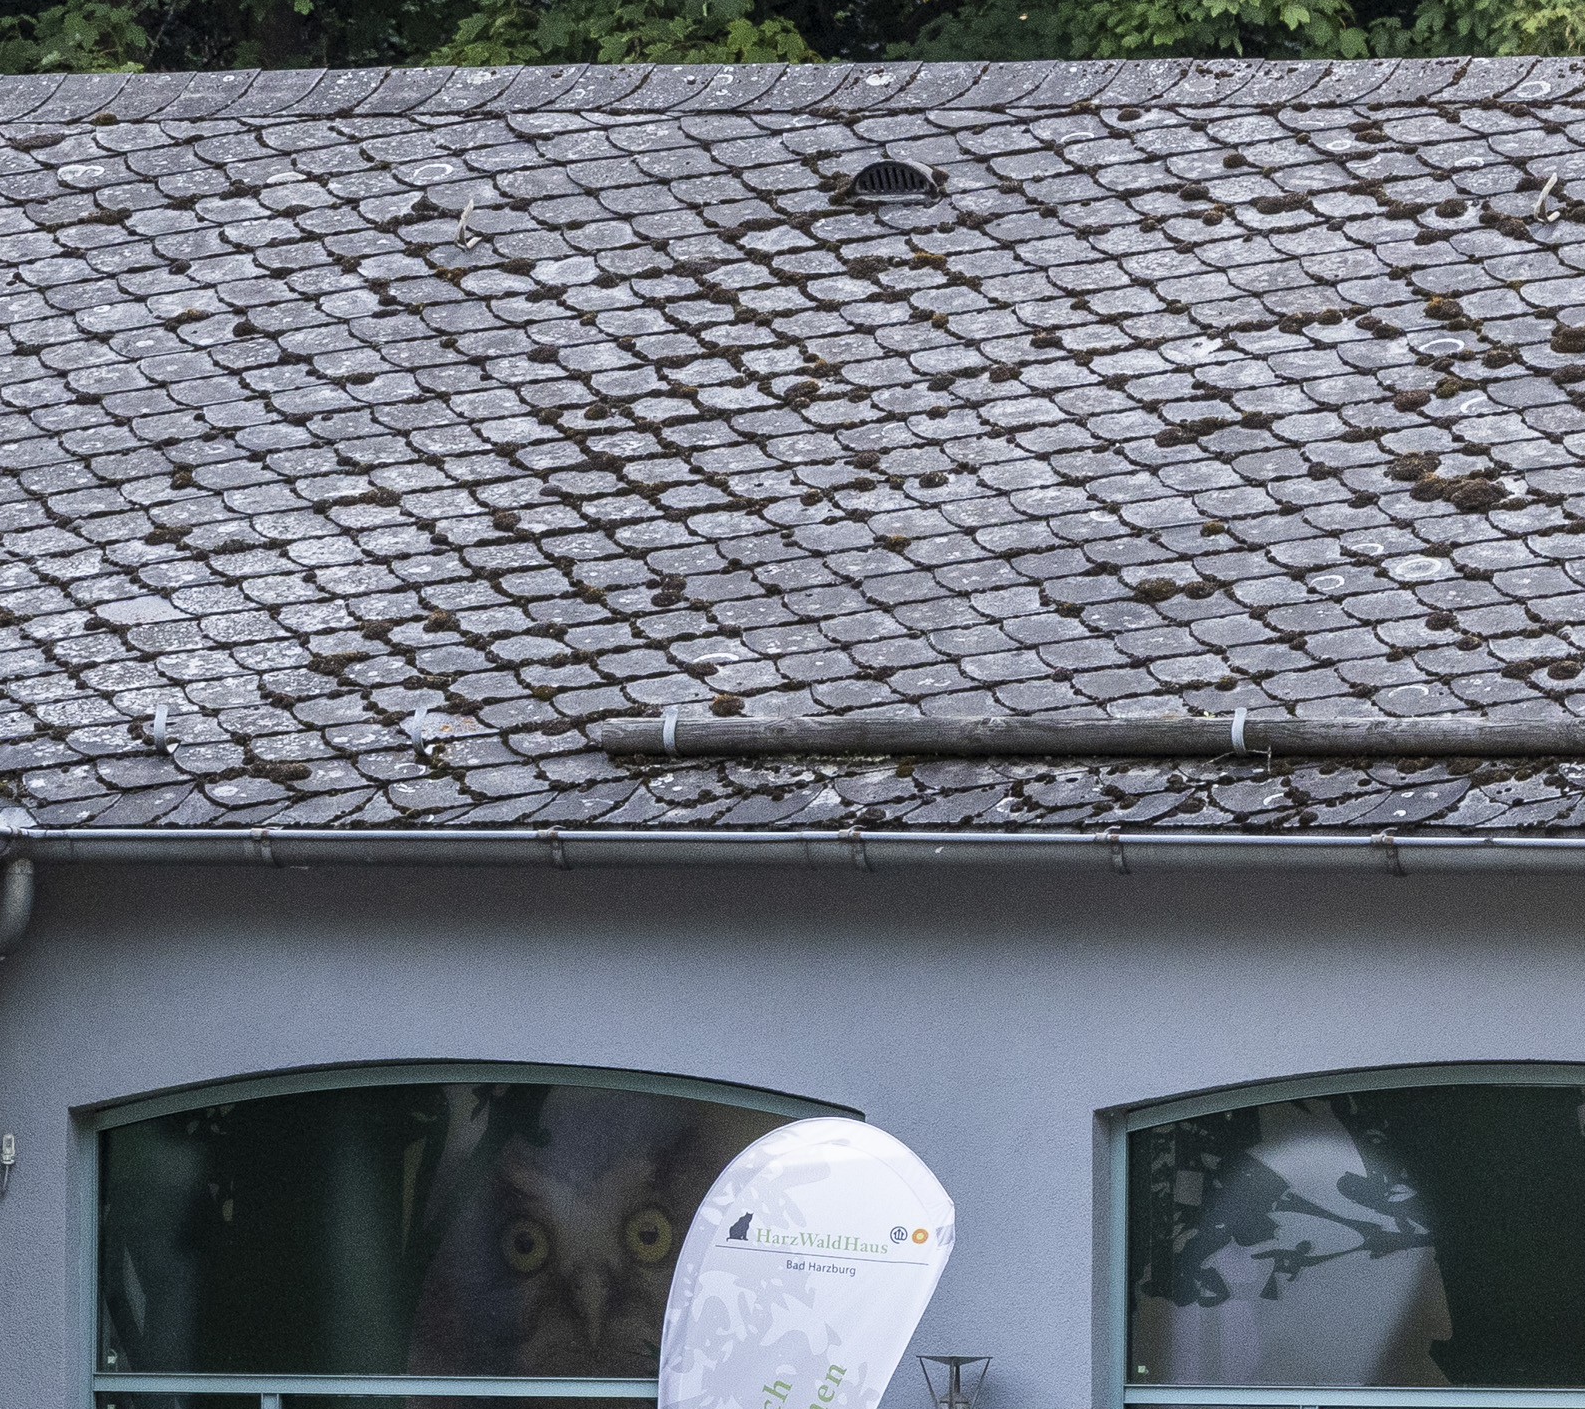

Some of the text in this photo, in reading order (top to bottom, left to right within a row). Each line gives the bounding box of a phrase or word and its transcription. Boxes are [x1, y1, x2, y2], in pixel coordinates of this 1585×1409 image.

[757, 1228, 889, 1255] HarzWaldHaus
[786, 1259, 856, 1278] Bad Harzburg
